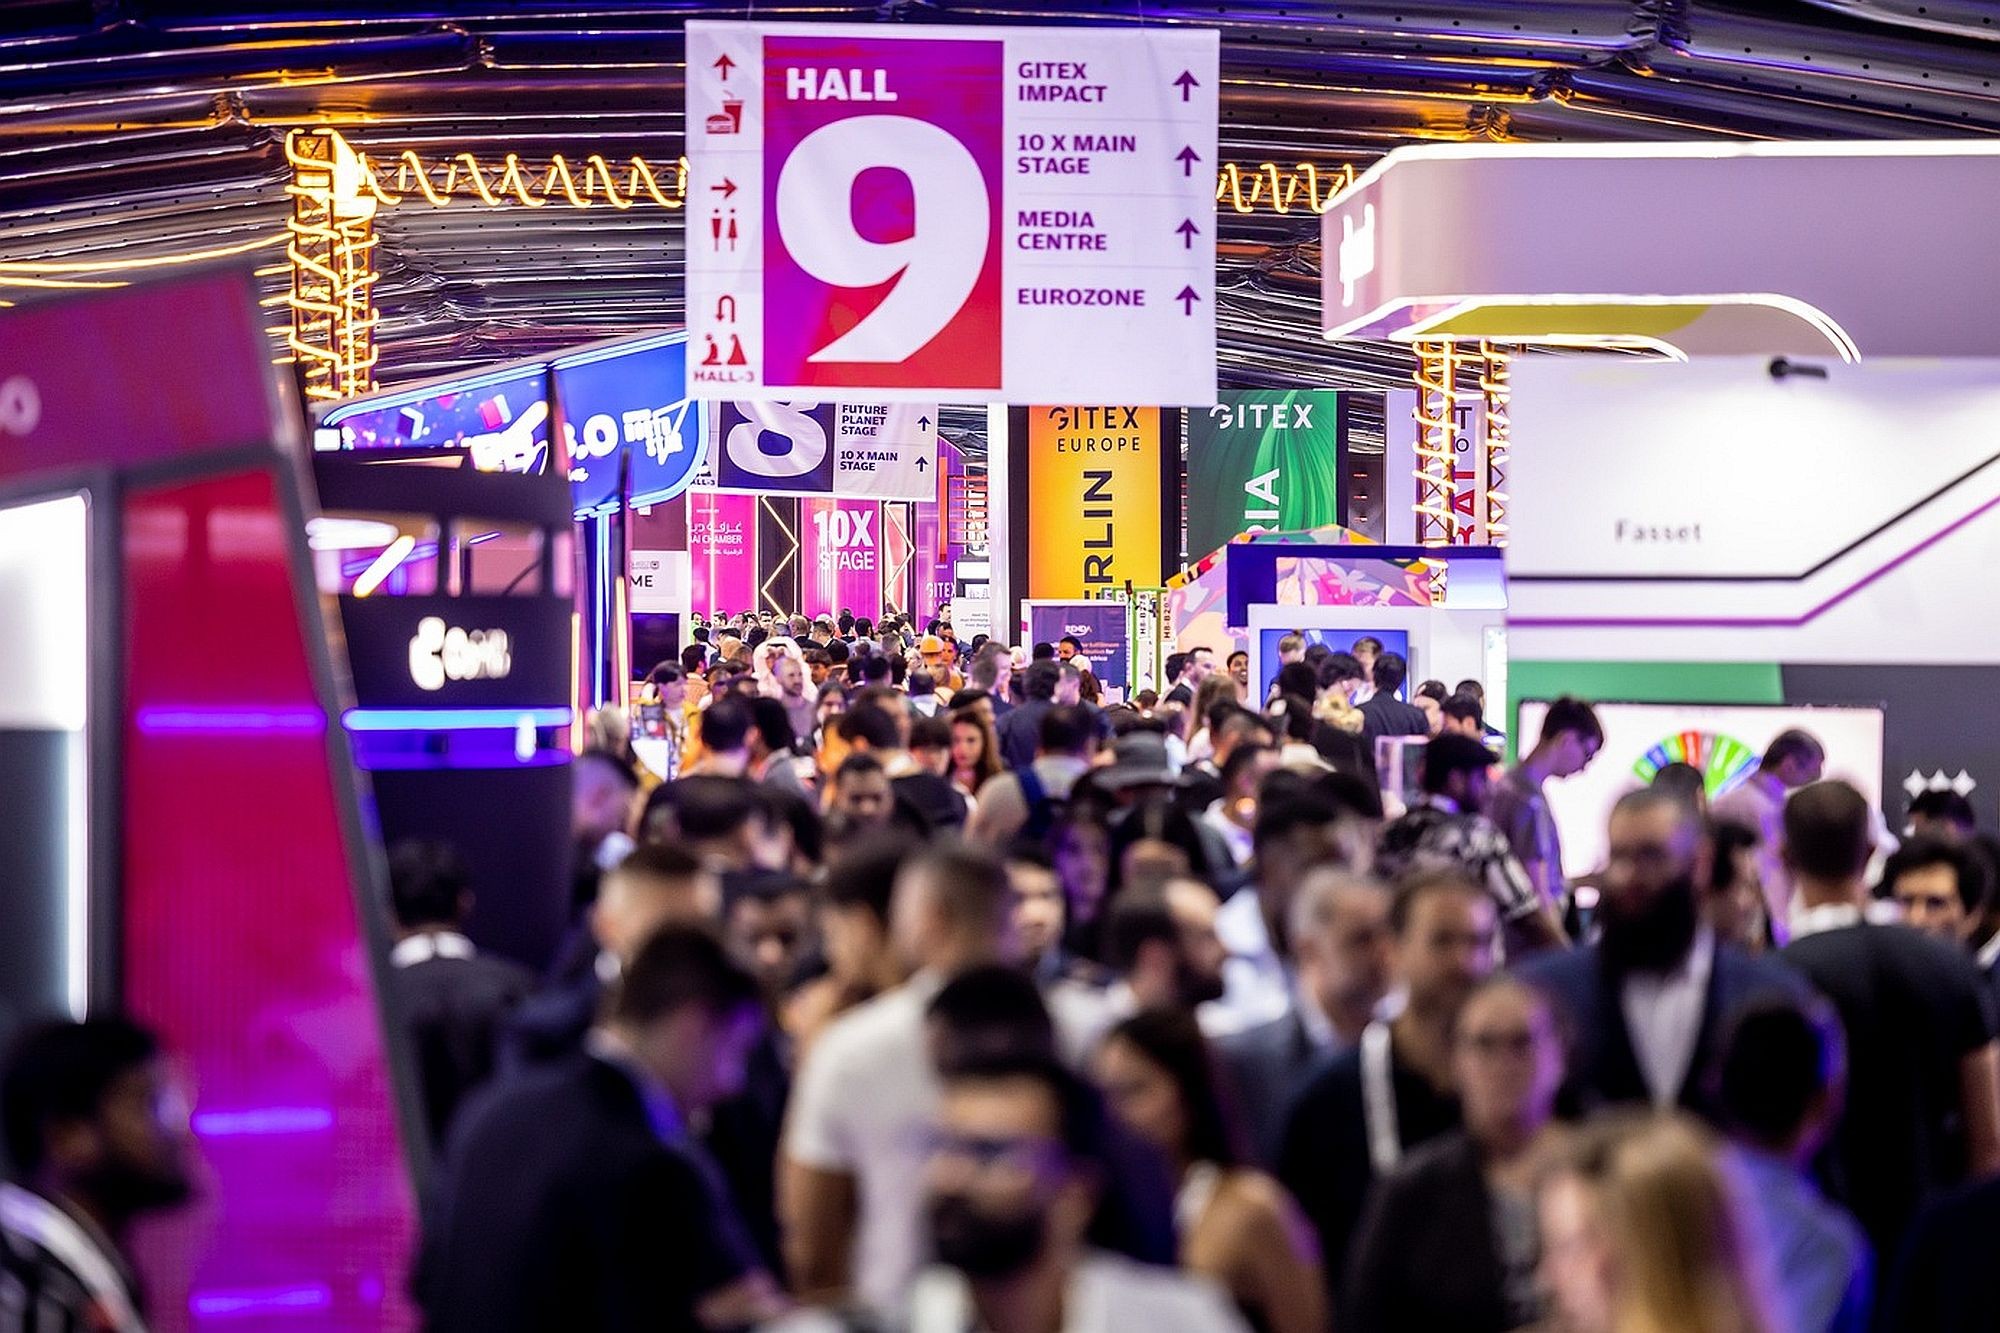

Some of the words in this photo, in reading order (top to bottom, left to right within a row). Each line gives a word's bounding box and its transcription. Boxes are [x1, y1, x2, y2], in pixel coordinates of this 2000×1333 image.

[1018, 62, 1087, 80] GITEX
[786, 67, 898, 102] HALL
[1018, 85, 1108, 103] IMPACT
[1018, 134, 1046, 152] 10
[1052, 135, 1067, 152] X
[1072, 135, 1136, 153] MAIN
[1018, 157, 1090, 175] STAGE
[1018, 211, 1095, 228] MEDIA
[776, 114, 990, 362] 9
[1018, 234, 1107, 251] CENTRE
[1018, 289, 1146, 306] EUROZONE
[694, 371, 755, 383] HALL-3
[842, 404, 888, 415] FUTURE
[1049, 406, 1139, 430] GITEX
[1209, 404, 1313, 430] GITEX
[842, 415, 886, 426] PLANET
[726, 402, 827, 477] 8
[841, 426, 877, 436] STAGE
[1057, 437, 1140, 453] EUROPE
[840, 450, 855, 460] 10
[857, 451, 865, 460] X
[866, 452, 898, 461] MAIN
[839, 461, 876, 471] STAGE
[813, 509, 875, 548] 10X
[1614, 518, 1703, 543] Fasset
[819, 551, 875, 571] STAGE
[926, 582, 956, 598] GITEX
